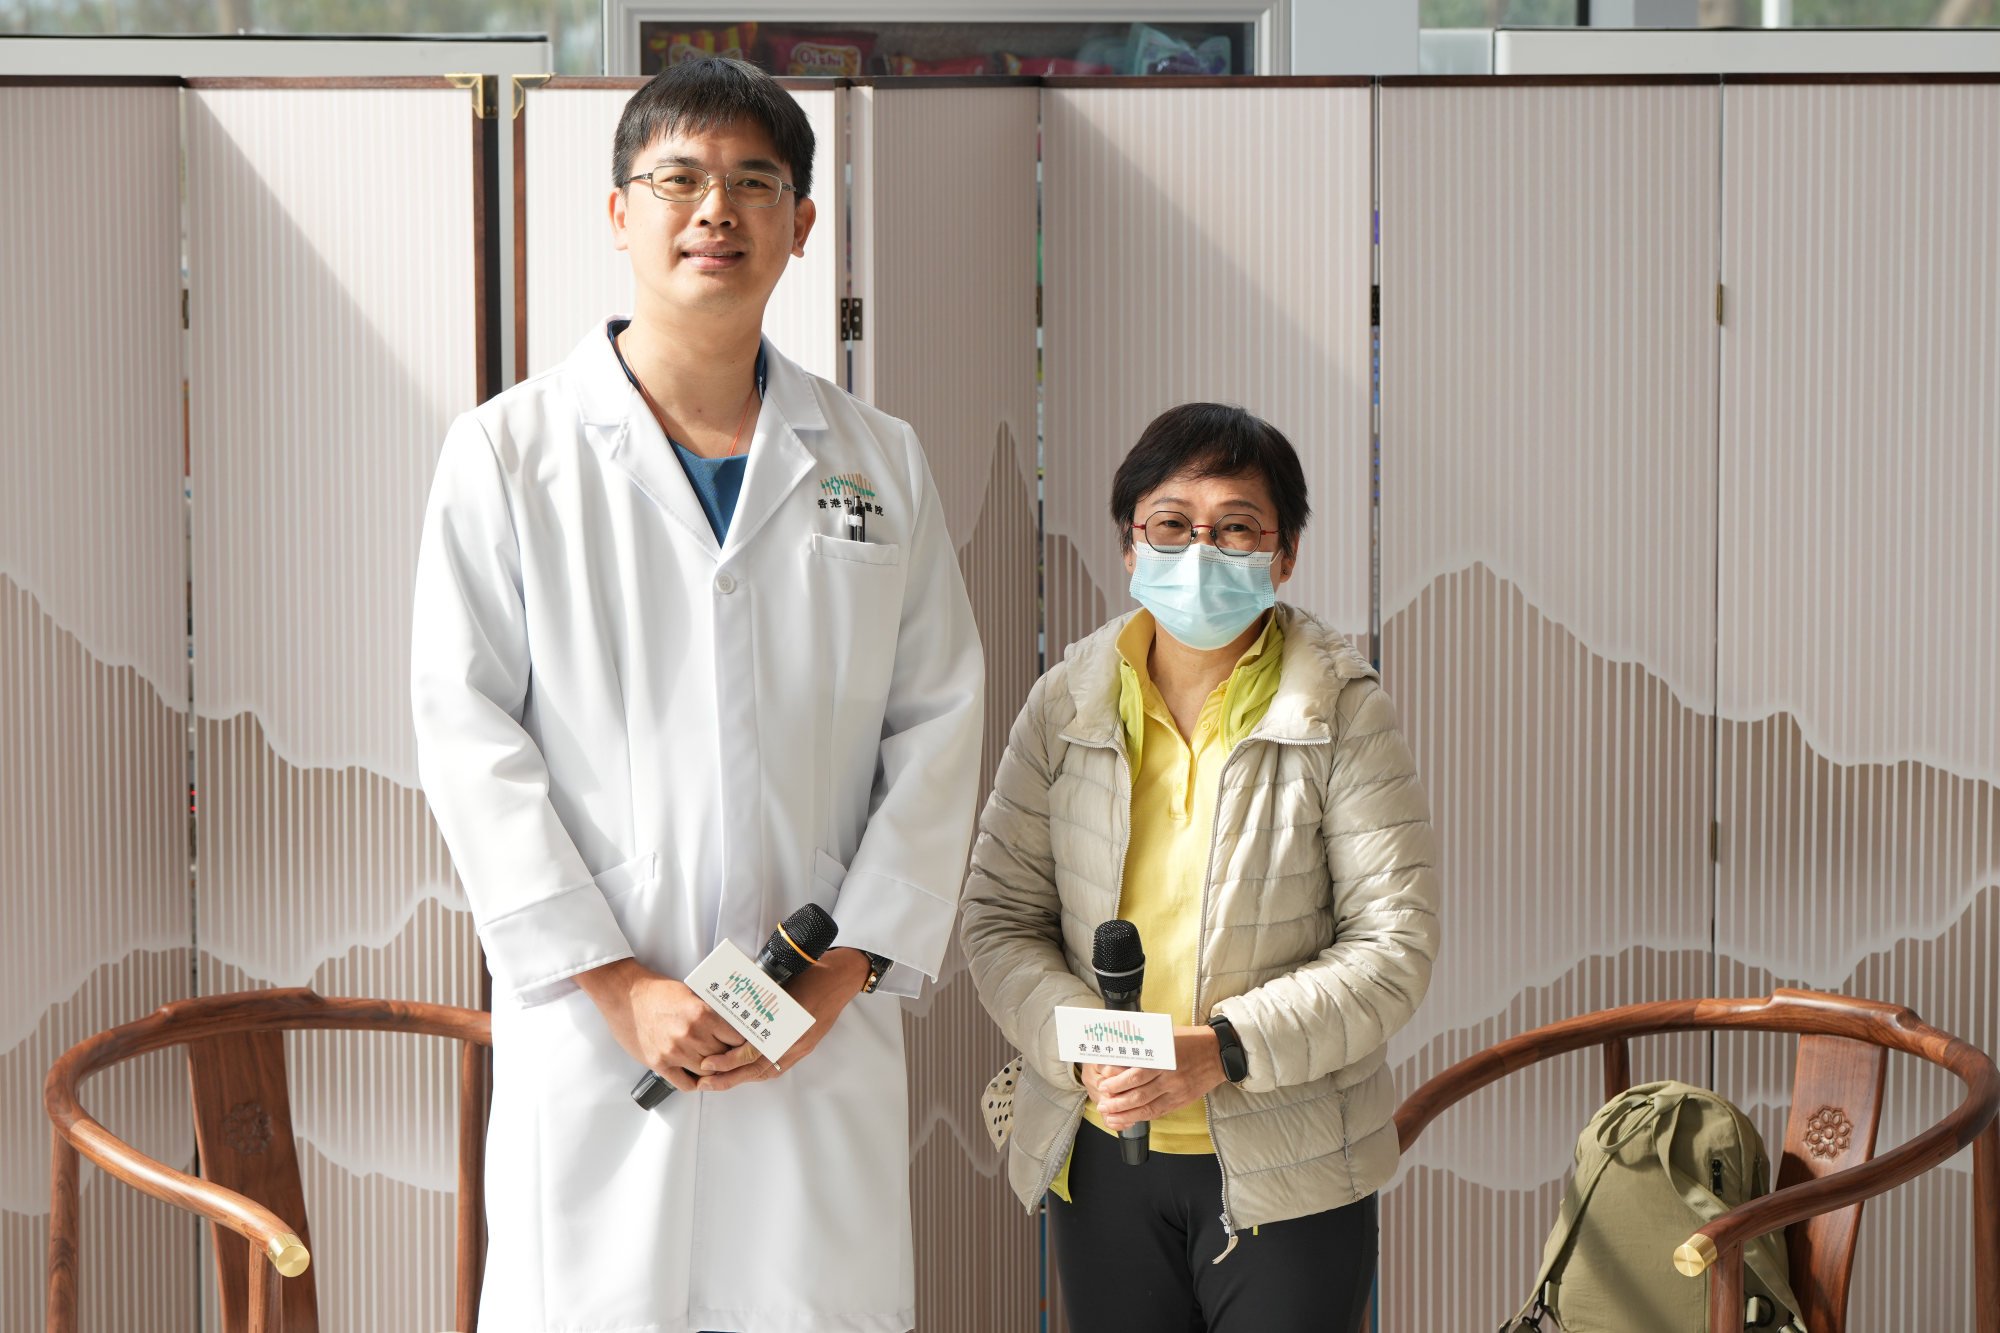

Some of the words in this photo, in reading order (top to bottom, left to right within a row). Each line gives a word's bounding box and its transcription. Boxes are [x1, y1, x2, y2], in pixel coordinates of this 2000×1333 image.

[817, 498, 884, 517] 香港中醫院
[709, 982, 772, 1040] 香港中醫醫院
[1078, 1043, 1154, 1058] 香港中醫醫院
